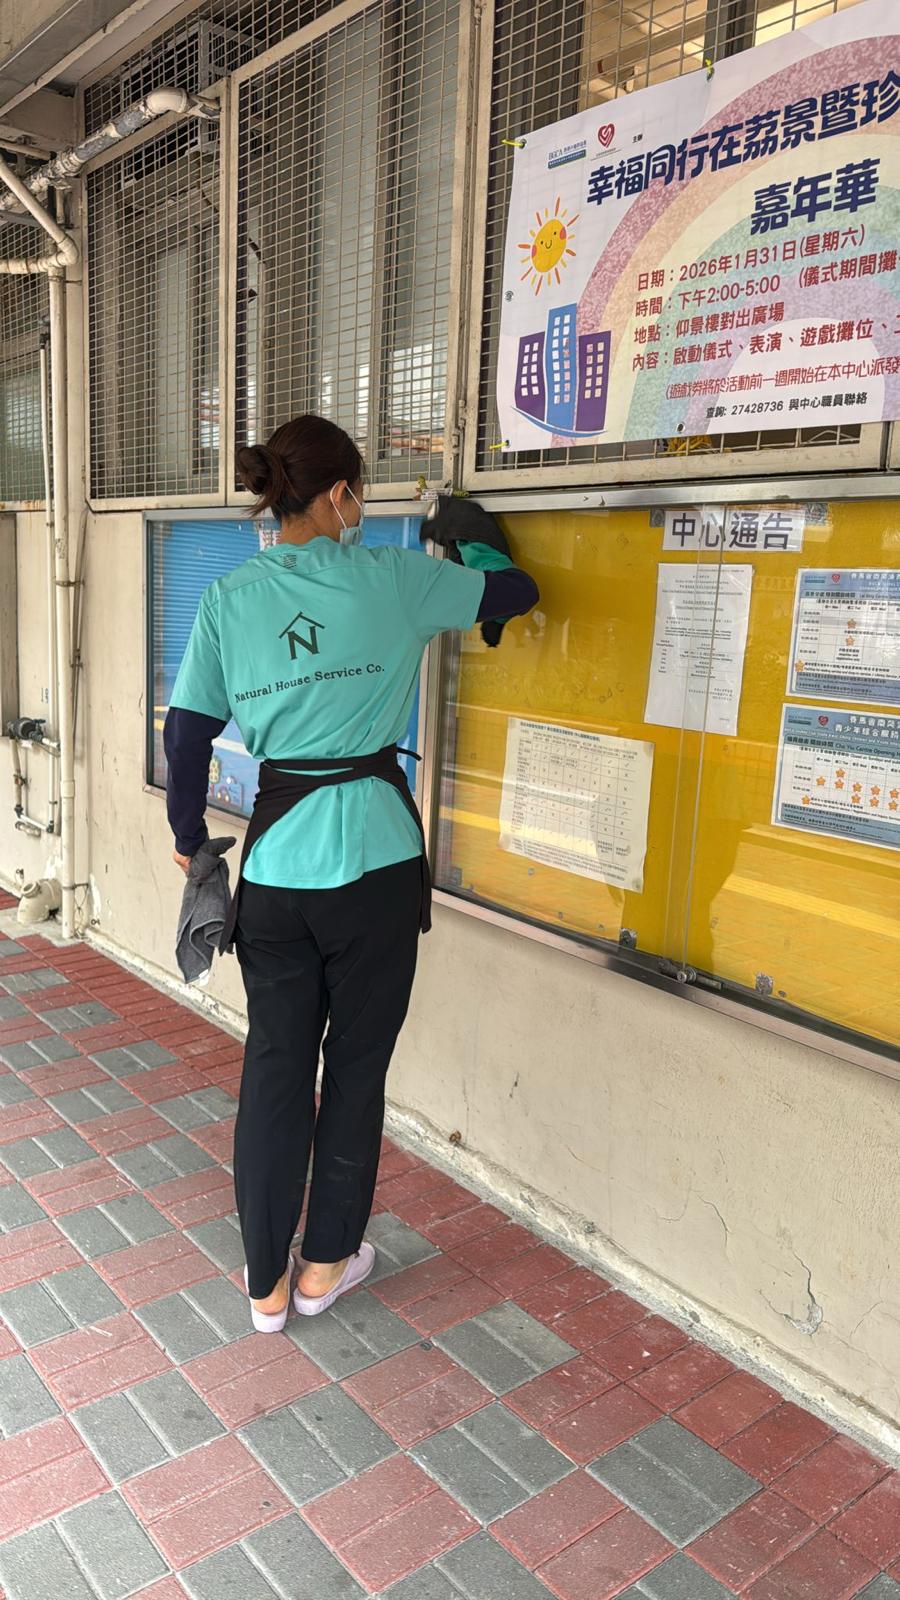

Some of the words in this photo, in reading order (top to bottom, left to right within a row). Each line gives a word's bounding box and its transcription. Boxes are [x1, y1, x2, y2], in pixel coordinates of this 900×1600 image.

[587, 70, 900, 206] 幸福同行在荔景暨珍
[750, 158, 880, 235] 嘉年華
[799, 249, 900, 288] (儀式期間攤
[731, 400, 784, 416] 27428736
[788, 391, 868, 411] 與中心職員聯絡
[672, 512, 794, 550] 中心通告
[287, 625, 321, 661] N
[235, 684, 272, 703] Natural
[275, 674, 311, 692] House
[314, 666, 363, 681] Service
[366, 663, 385, 674] Co.
